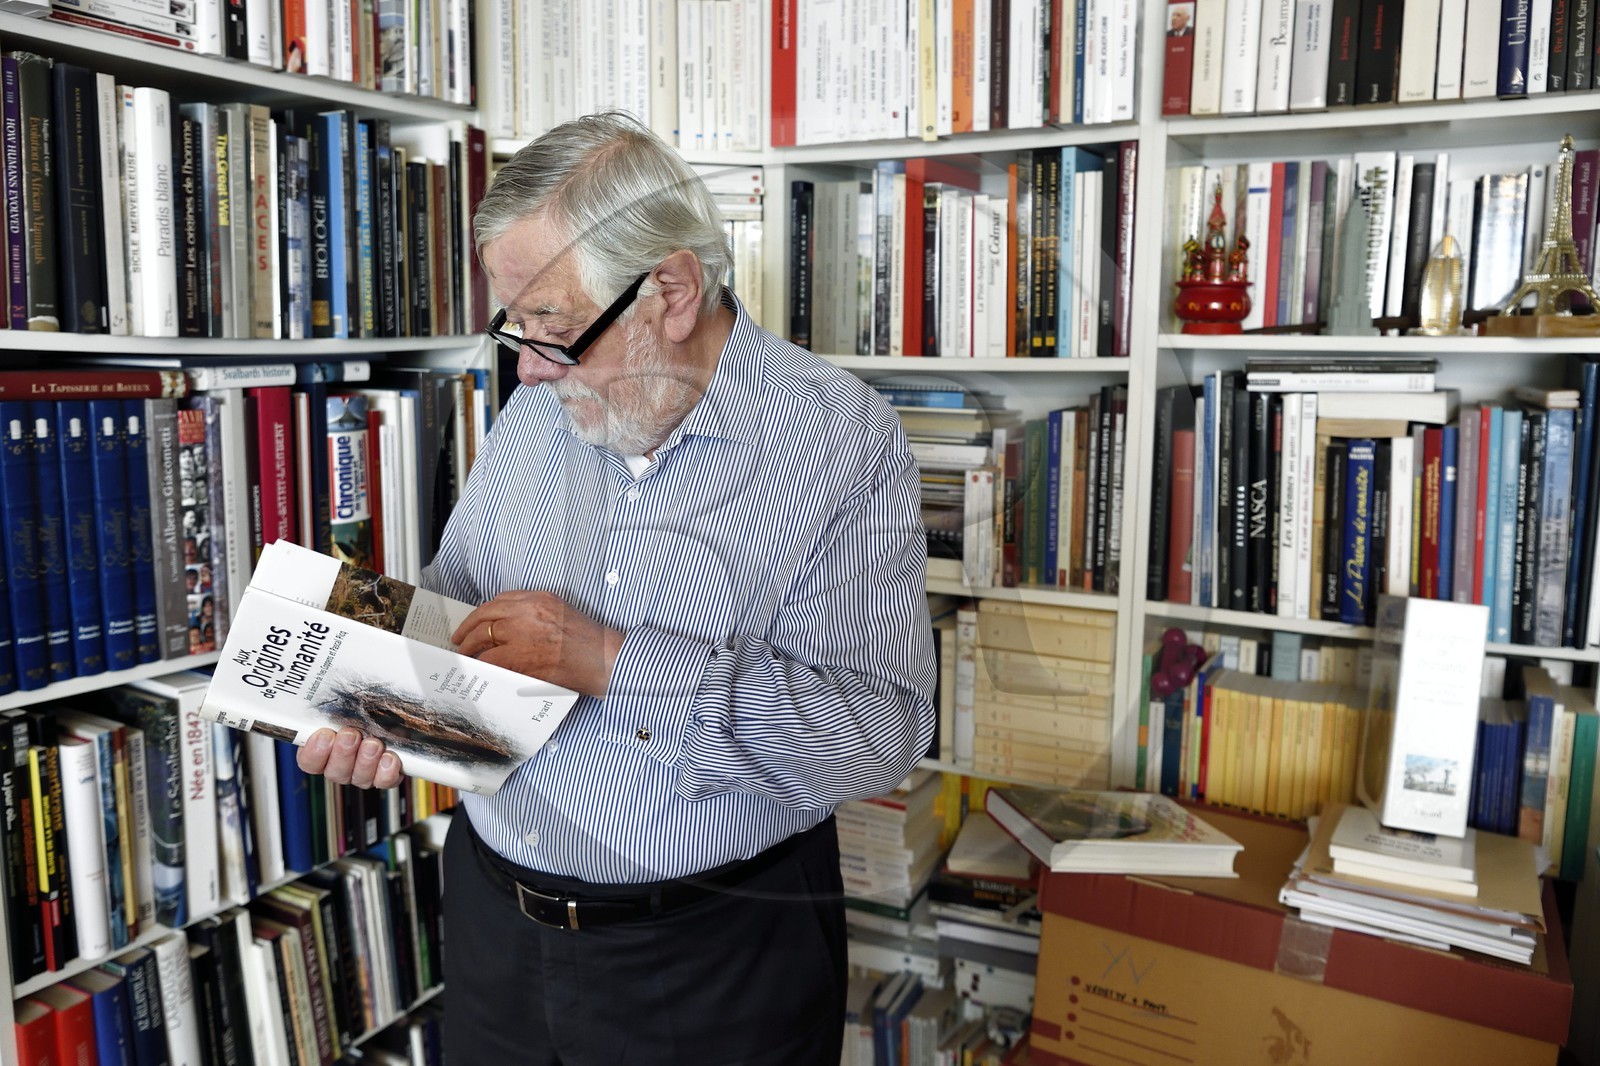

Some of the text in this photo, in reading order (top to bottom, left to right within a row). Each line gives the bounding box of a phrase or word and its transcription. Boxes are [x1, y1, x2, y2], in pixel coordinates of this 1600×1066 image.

[1506, 0, 1528, 46] Umber
[1119, 49, 1128, 77] Nicolas
[29, 116, 42, 160] Evolution
[5, 118, 20, 234] HOW HUMANS EVOLVED
[32, 163, 43, 173] of
[155, 163, 169, 202] blanc
[215, 134, 230, 227] The Great Wall
[1577, 161, 1591, 215] Jacques Attali
[32, 175, 44, 212] African
[127, 151, 141, 272] SICILE MERVEILLEUSE
[181, 120, 196, 268] Les origines de l'homme
[361, 183, 371, 225] ESPACES
[156, 205, 171, 258] Paradis
[256, 174, 268, 271] FACES
[313, 194, 329, 279] BIOLOGIE
[988, 209, 1001, 255] Colmar
[222, 366, 292, 380] Svalbards historie
[159, 426, 174, 496] Giacometti
[333, 435, 359, 519] Chronique
[1096, 412, 1110, 567] THE SABER-TOOTHED CAT OF THE NORTH SEA
[1282, 475, 1295, 527] Ardennes
[1354, 465, 1369, 518] connaître
[1517, 464, 1527, 507] LASCAUX
[1250, 478, 1268, 538] NASCA
[1353, 518, 1366, 534] de
[1516, 509, 1525, 520] de
[1282, 529, 1293, 549] Les
[1346, 535, 1365, 580] Passion
[1515, 545, 1523, 562] des
[1327, 573, 1337, 602] MONET
[1345, 581, 1364, 611] La
[1514, 563, 1522, 593] Secret
[1513, 595, 1521, 606] Le
[232, 648, 252, 667] Aux
[242, 625, 292, 688] Origines
[260, 620, 330, 699] de l'humanité
[320, 655, 333, 670] Coppens
[329, 640, 342, 653] Pascal
[336, 630, 350, 641] Picq
[429, 672, 440, 681] De
[434, 666, 458, 694] l'apparition
[450, 686, 457, 695] de
[531, 700, 553, 723] Fayard
[186, 706, 206, 801] Née en 1842
[2, 771, 13, 784] Le
[2, 785, 14, 807] jour
[45, 746, 64, 831] Swartkrans
[167, 798, 181, 819] Le
